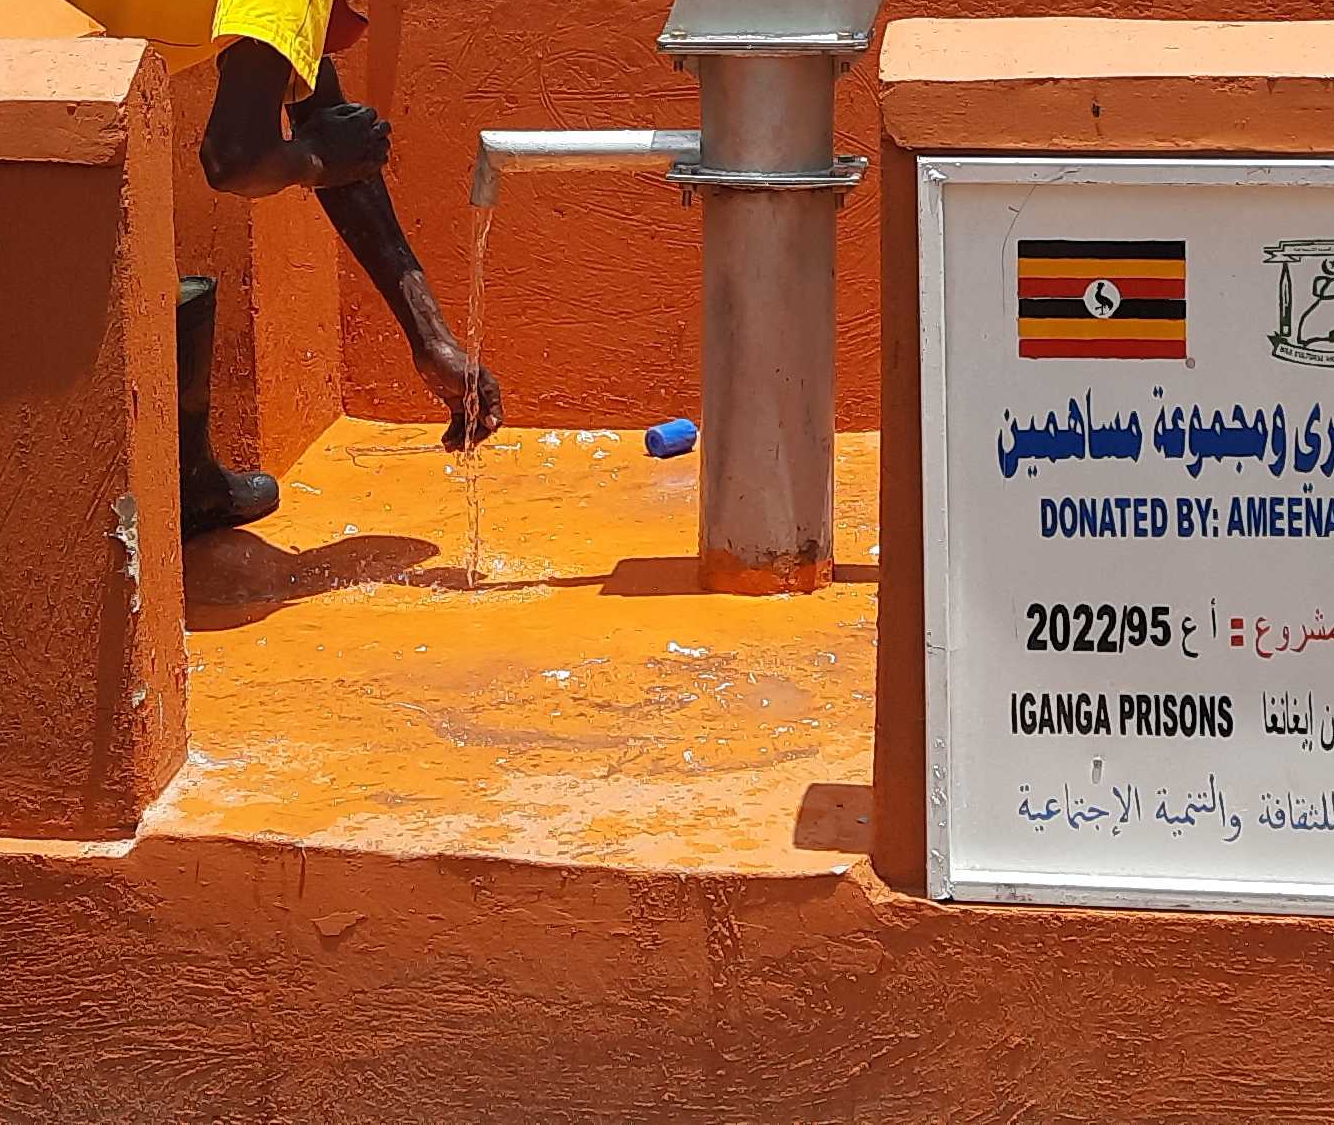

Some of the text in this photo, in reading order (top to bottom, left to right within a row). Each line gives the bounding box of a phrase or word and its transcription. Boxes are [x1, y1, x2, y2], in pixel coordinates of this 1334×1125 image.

[997, 387, 1143, 479] مساهمين
[1152, 385, 1287, 480] ومجموعة
[1040, 496, 1169, 539] DONATED
[1176, 497, 1220, 538] BY:
[1026, 602, 1172, 654] 2022/95
[1010, 692, 1234, 738] IGANGA PRISONS
[1155, 773, 1242, 843] والتنمية
